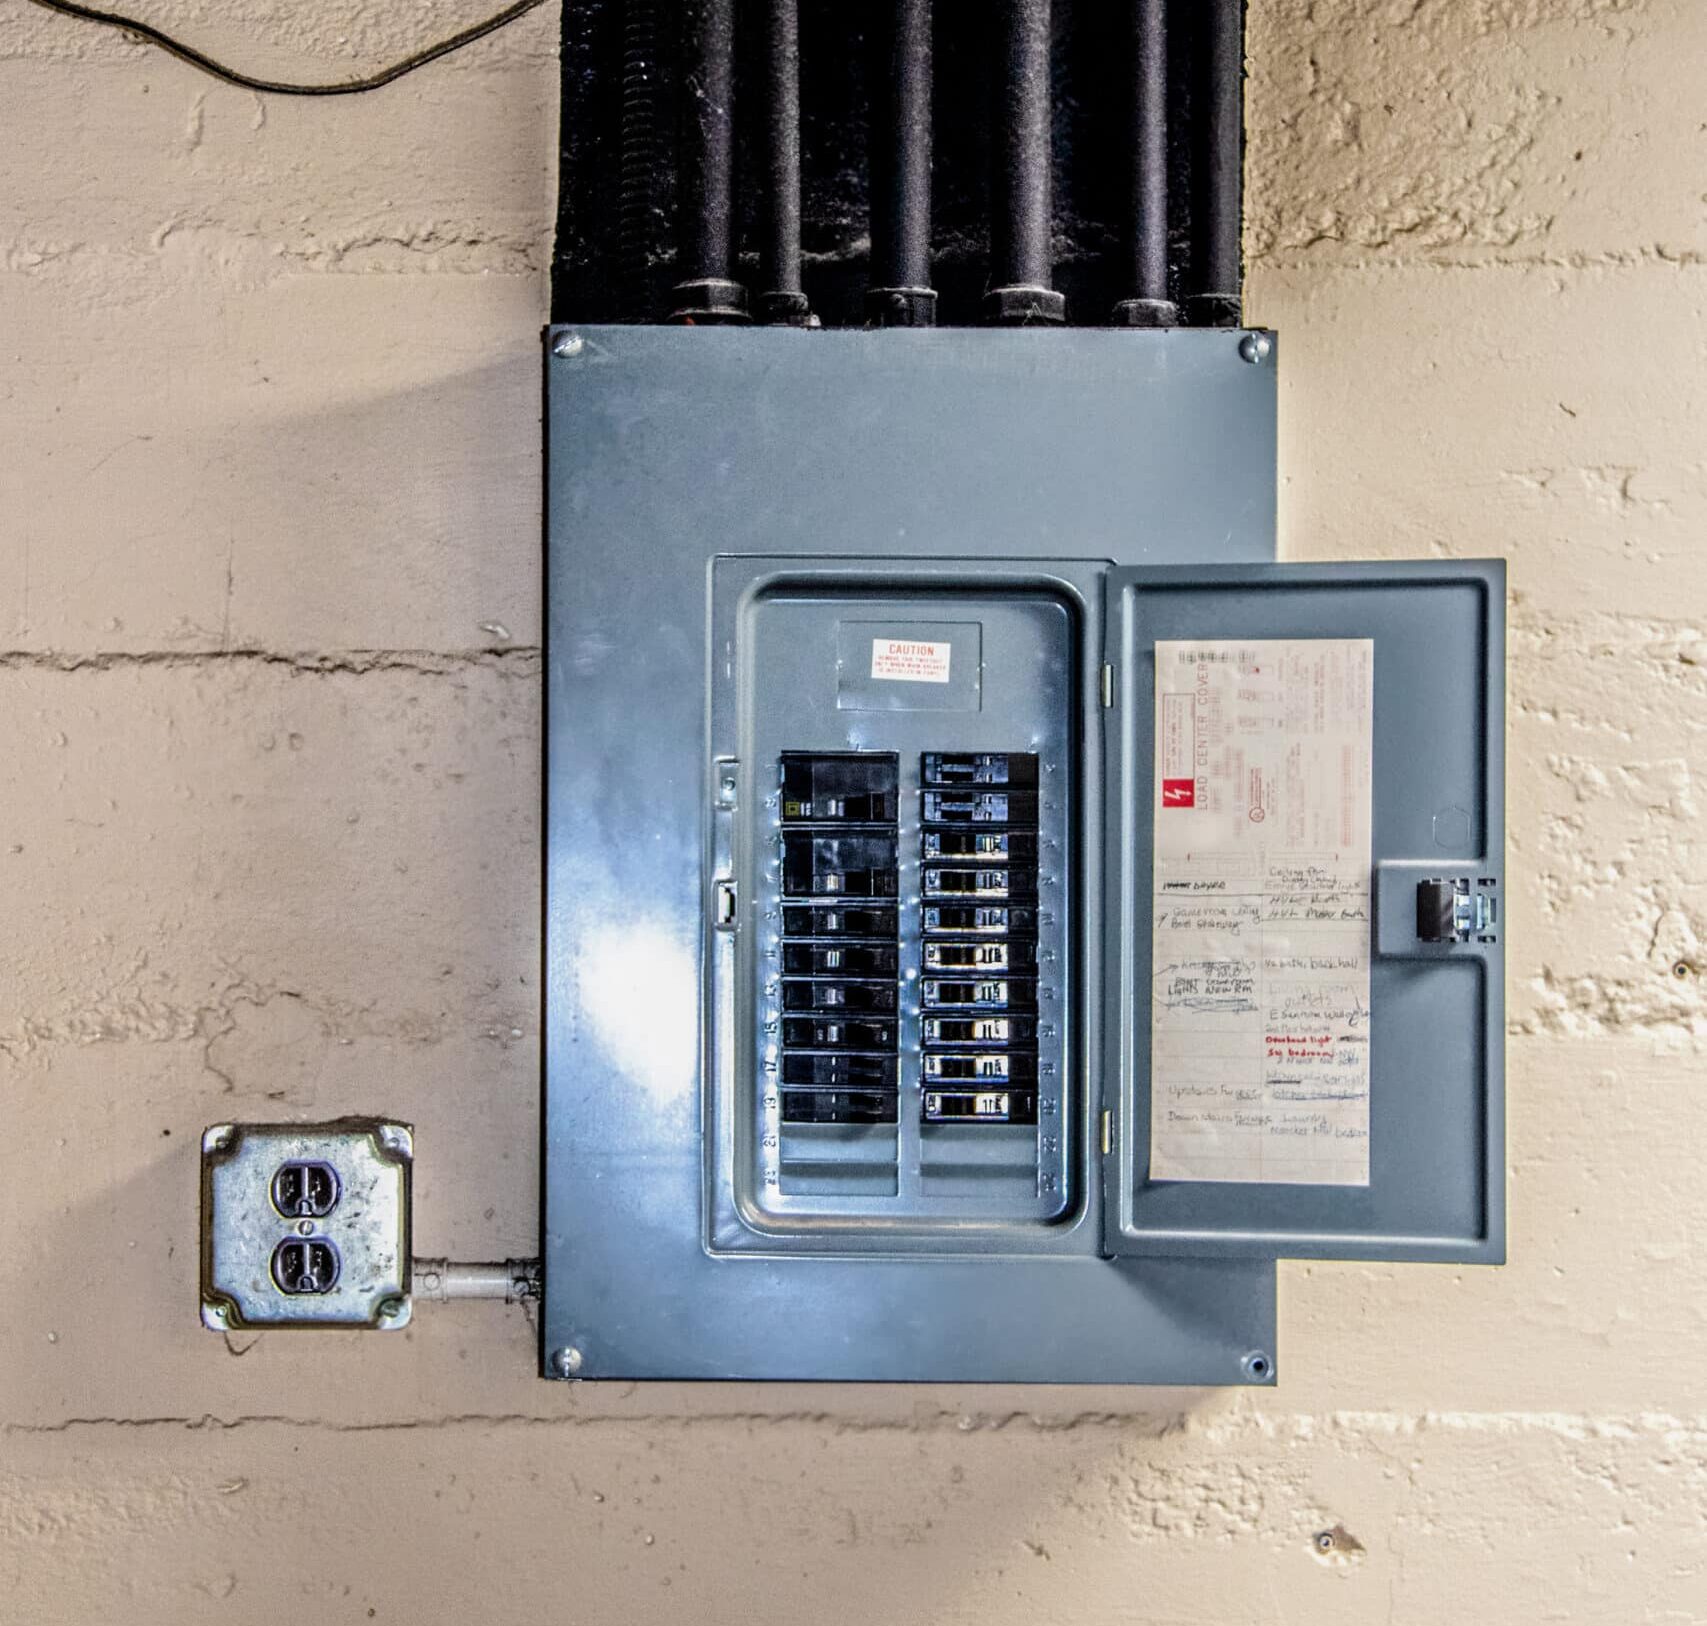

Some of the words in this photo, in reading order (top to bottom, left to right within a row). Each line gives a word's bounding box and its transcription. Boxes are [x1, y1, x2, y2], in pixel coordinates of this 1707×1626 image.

[889, 644, 935, 656] CAUTION
[1196, 662, 1209, 706] COVER
[1196, 715, 1209, 767] CENTER
[1197, 775, 1209, 811] LOAD
[763, 984, 778, 997] 13
[764, 1021, 778, 1034] 15
[1288, 1047, 1335, 1059] bedroom
[763, 1060, 778, 1073] 17
[763, 1097, 777, 1110] 19
